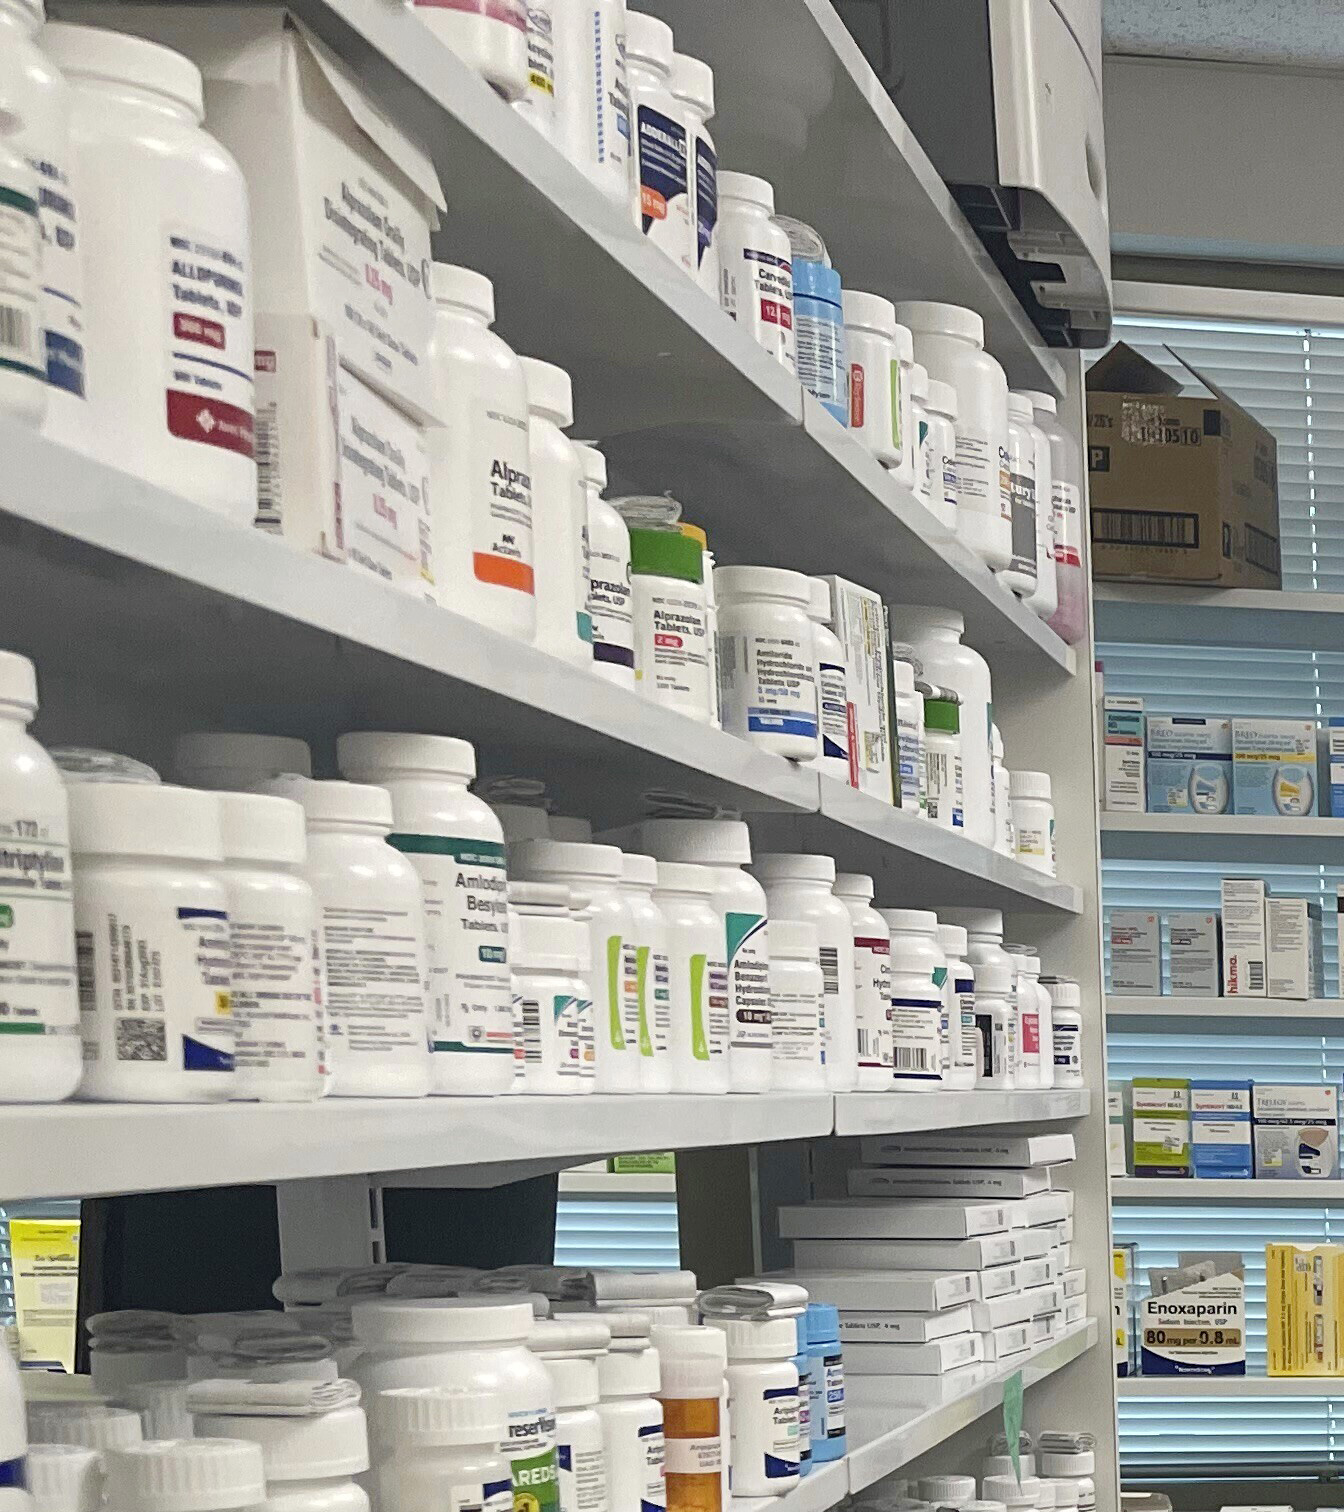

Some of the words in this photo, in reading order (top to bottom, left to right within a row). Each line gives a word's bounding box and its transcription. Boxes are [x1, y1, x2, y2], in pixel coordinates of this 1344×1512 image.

[1148, 1302, 1237, 1317] Enoxaparin
[1147, 1331, 1165, 1344] 80
[1182, 1335, 1198, 1346] per
[1199, 1331, 1224, 1345] 0.8
